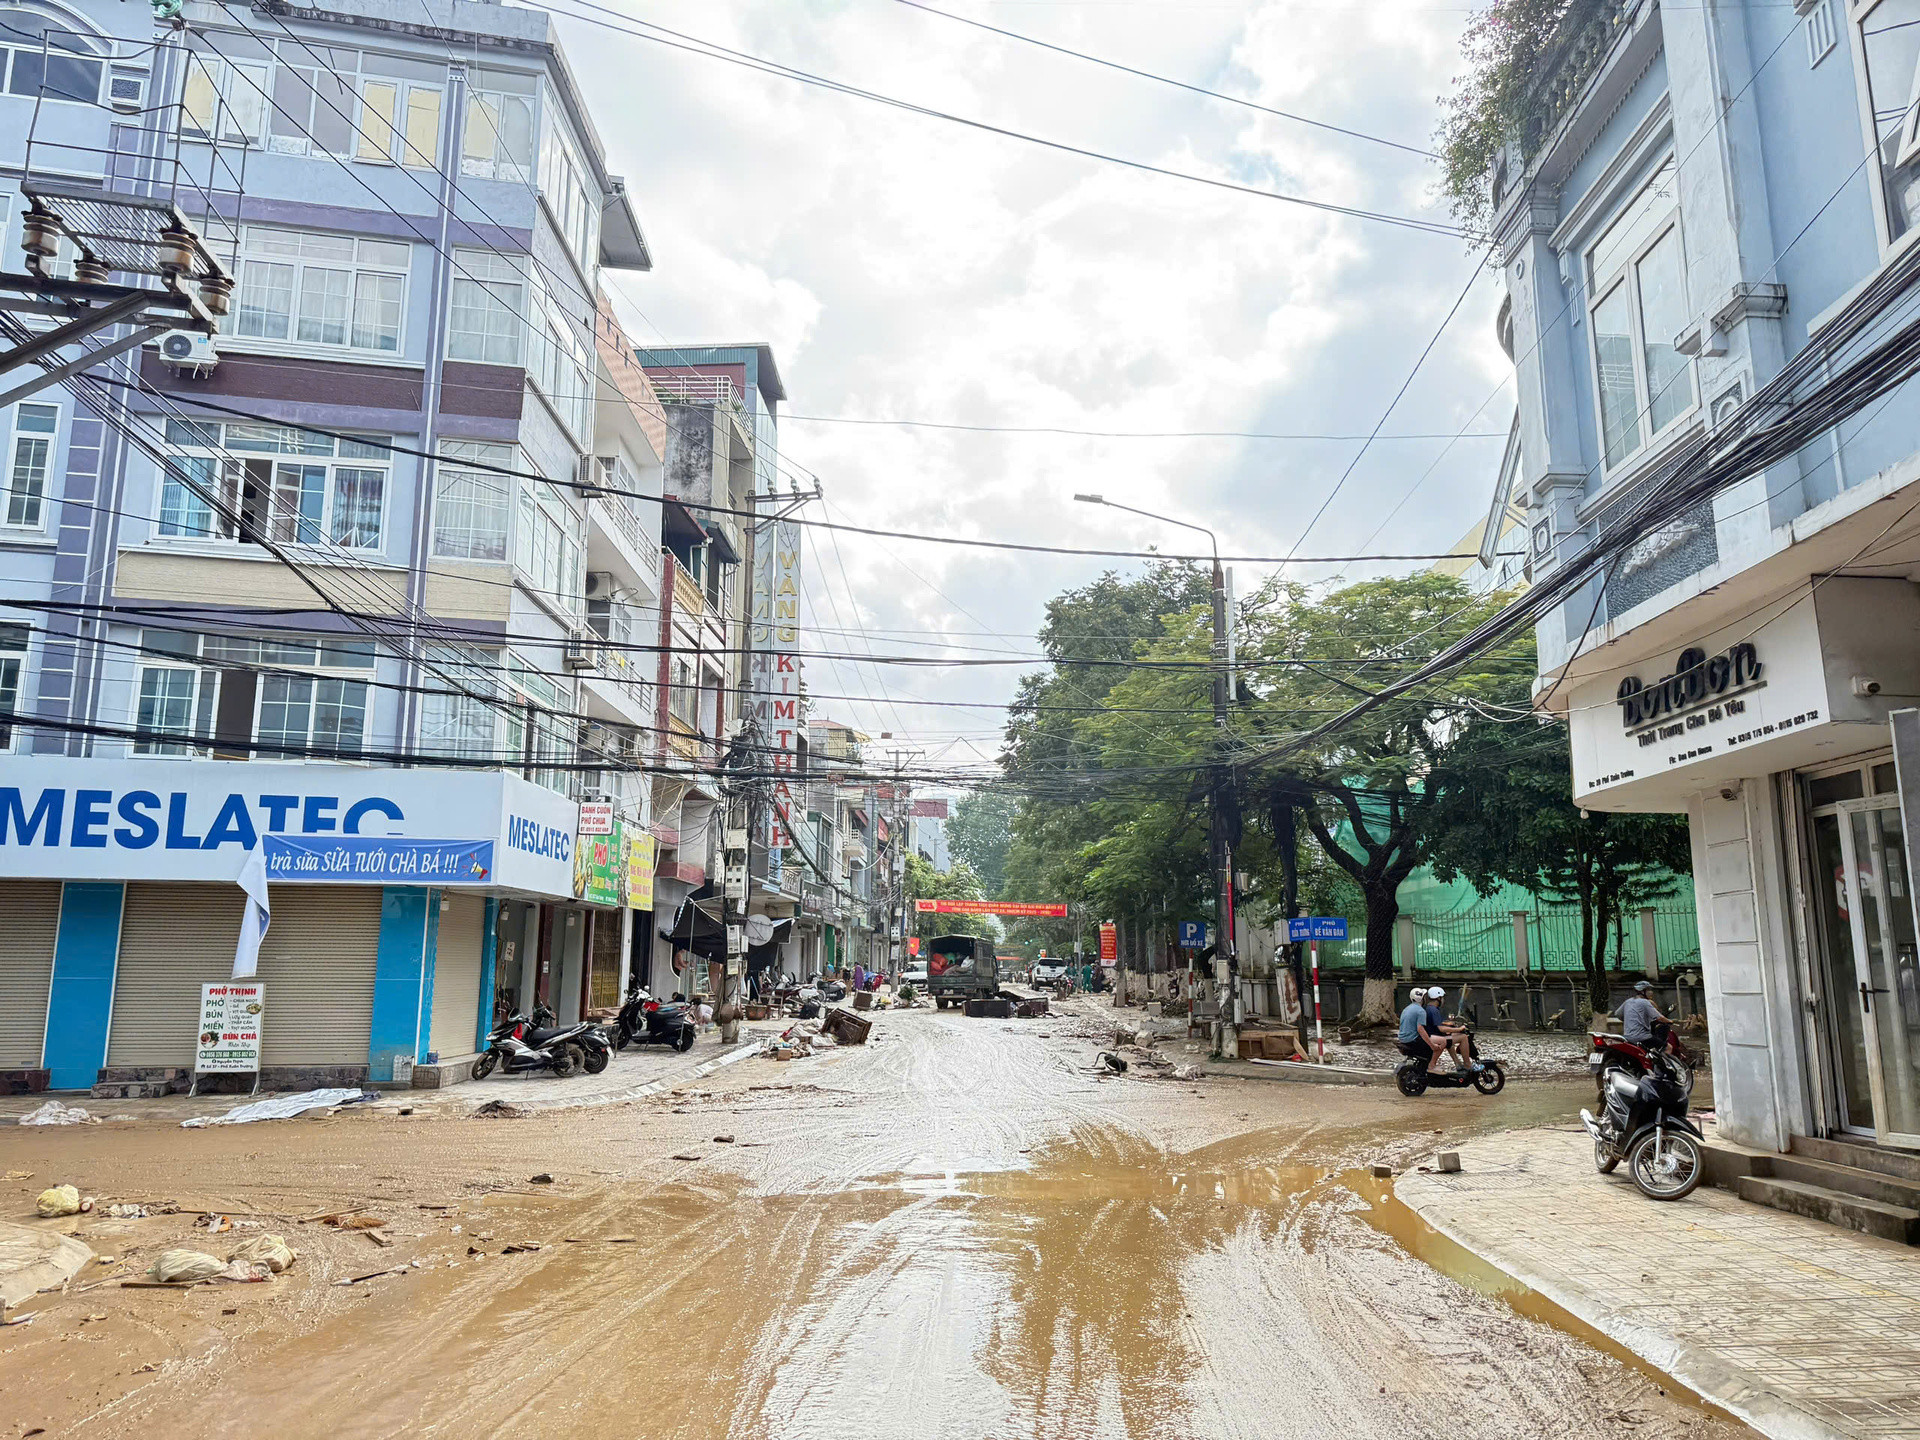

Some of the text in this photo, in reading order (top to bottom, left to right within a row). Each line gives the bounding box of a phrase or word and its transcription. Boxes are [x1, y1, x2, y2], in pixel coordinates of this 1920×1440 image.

[777, 551, 797, 642] VÀNG
[774, 655, 795, 719] KIM
[1637, 700, 1745, 747] Thời Trang Cho Bé Yêu
[1807, 709, 1819, 721] 732
[0, 787, 404, 850] MESLATEC
[508, 814, 569, 862] MESLATEC
[271, 850, 292, 870] trà
[294, 851, 319, 871] sữa
[321, 846, 350, 872] SỮA
[354, 847, 387, 873] TƯỚI
[389, 848, 417, 874] CHÀ
[420, 848, 441, 874] BÁ
[443, 853, 459, 874] !!!
[1187, 923, 1197, 938] P
[206, 997, 225, 1007] PHỞ
[229, 988, 257, 996] THỊNH
[205, 1009, 223, 1019] BÚN
[222, 1031, 257, 1040] BÚN CHẢ
